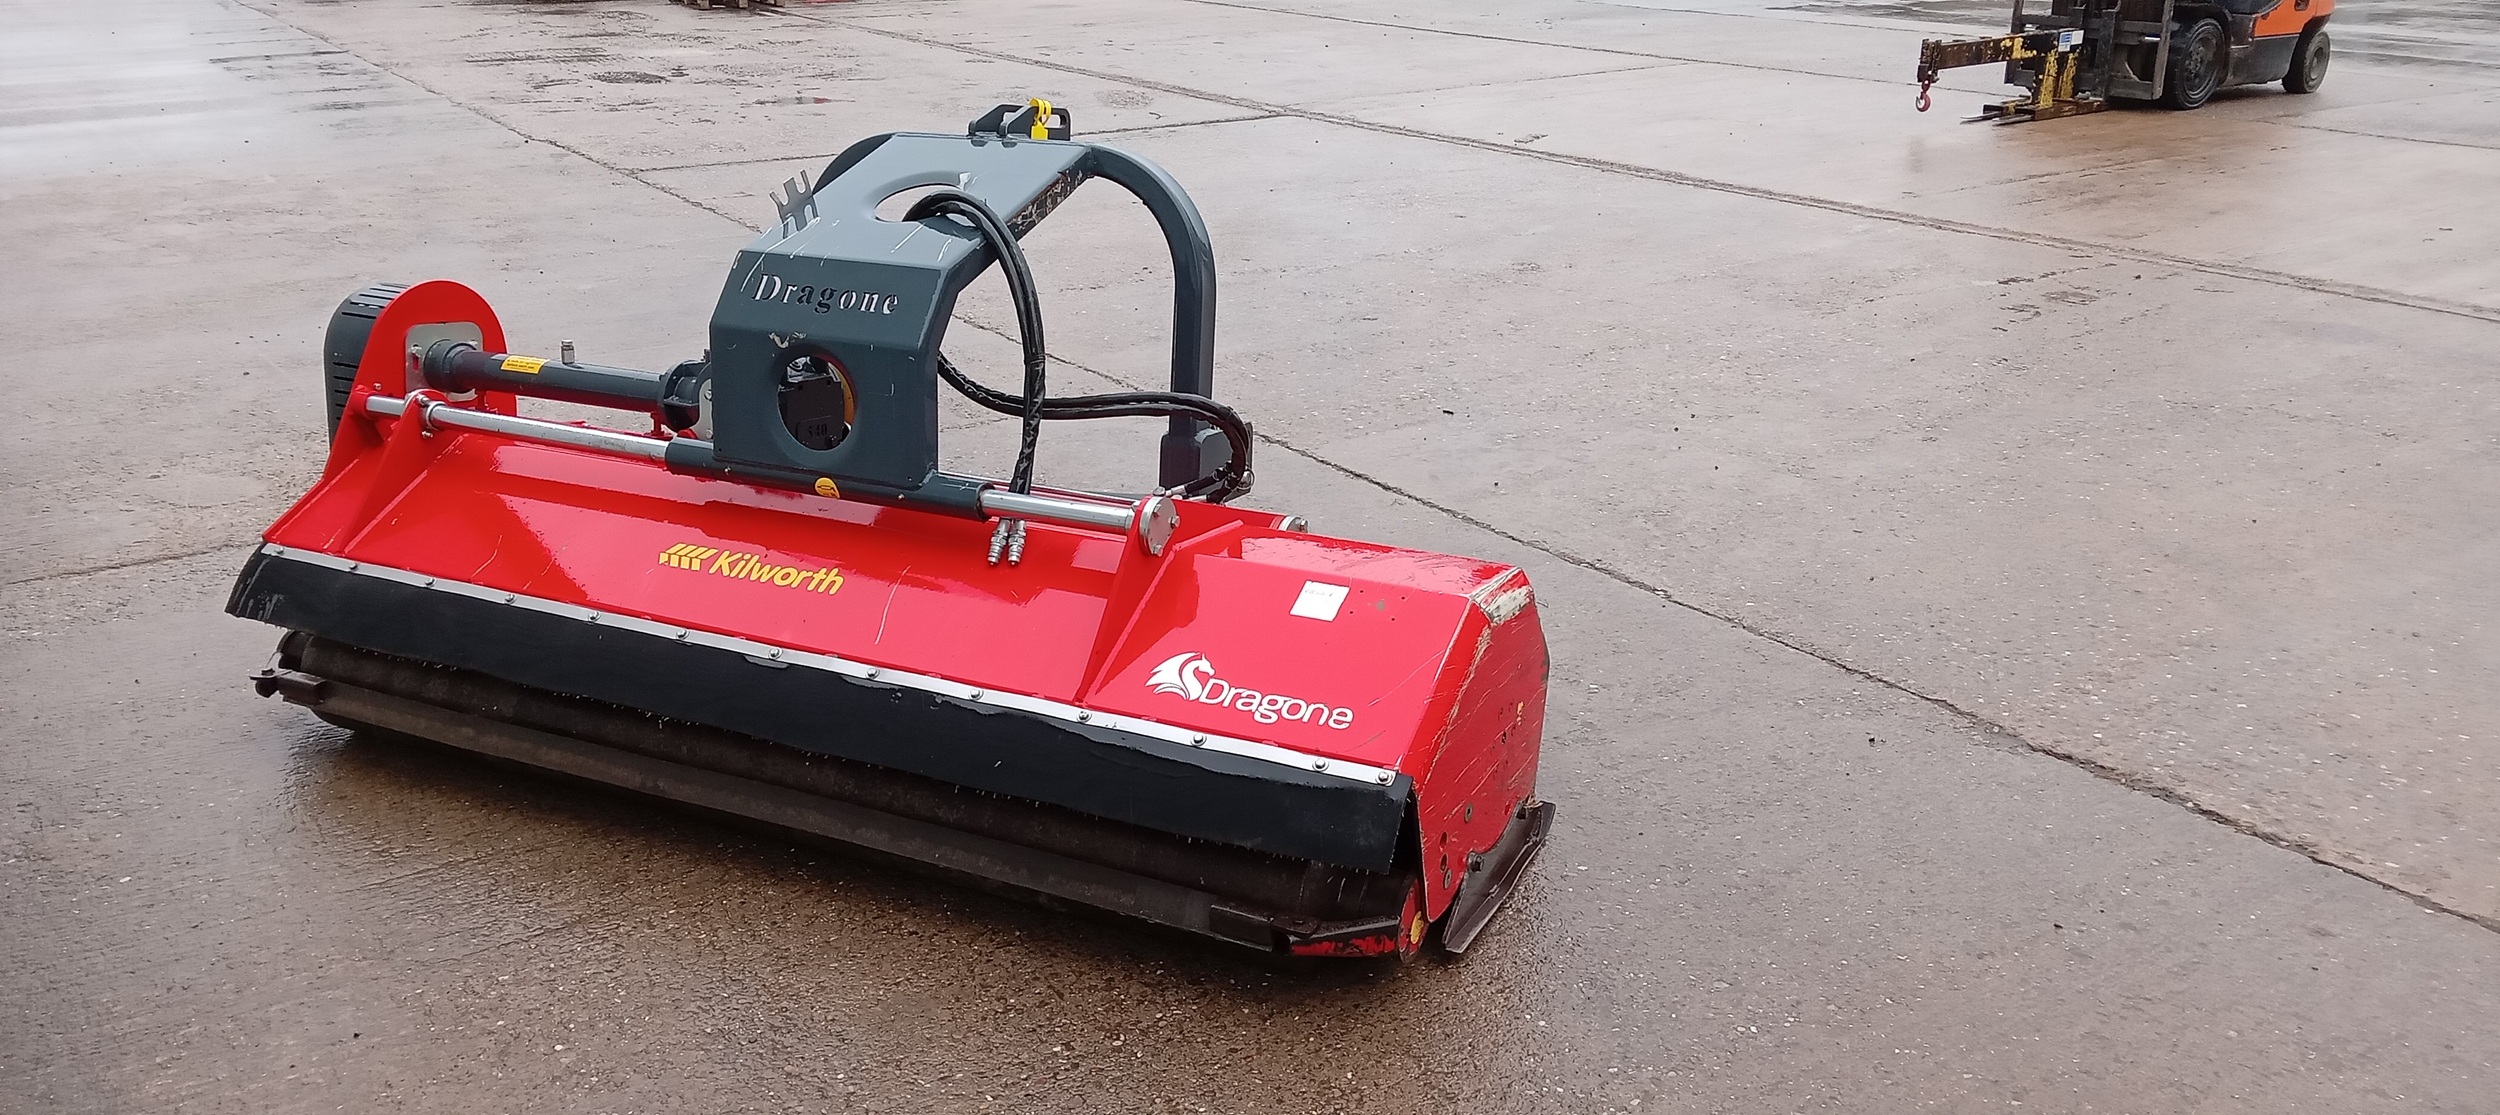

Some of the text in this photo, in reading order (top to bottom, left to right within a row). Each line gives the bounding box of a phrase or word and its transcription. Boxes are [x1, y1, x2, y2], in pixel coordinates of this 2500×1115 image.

[751, 273, 900, 315] Dragone
[708, 550, 845, 595] Kilworth
[1197, 677, 1355, 730] Dragone
